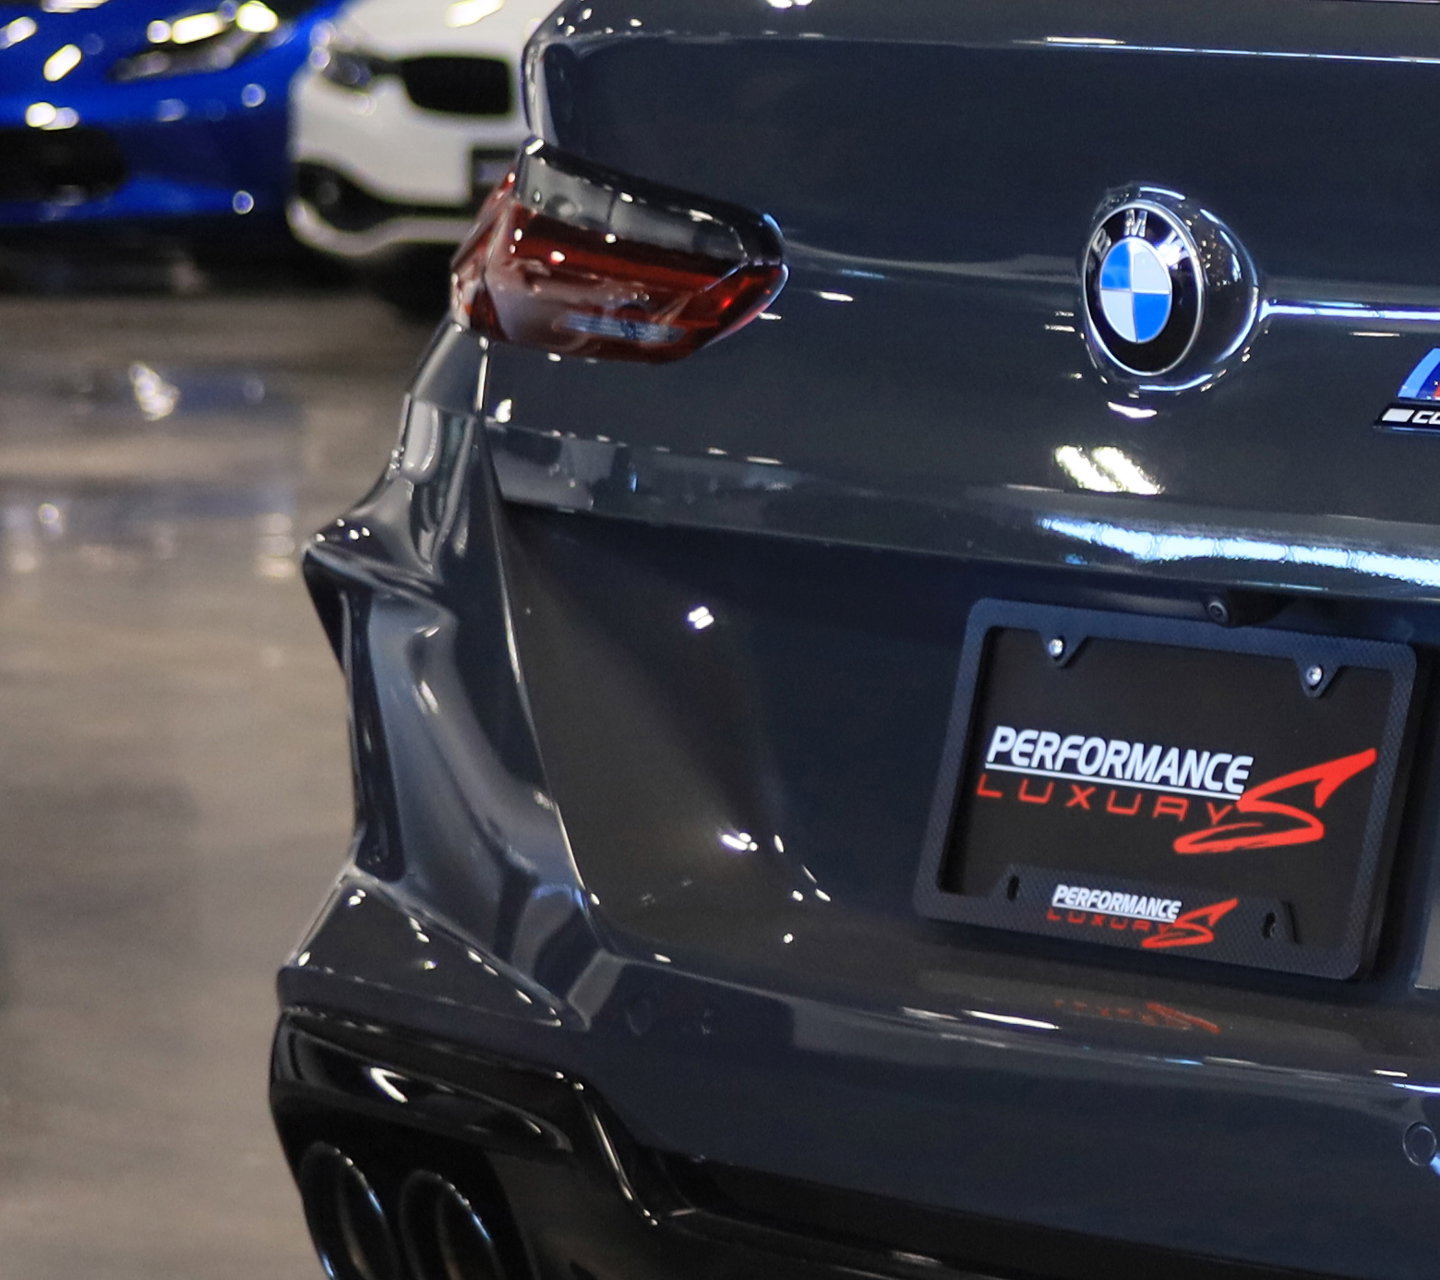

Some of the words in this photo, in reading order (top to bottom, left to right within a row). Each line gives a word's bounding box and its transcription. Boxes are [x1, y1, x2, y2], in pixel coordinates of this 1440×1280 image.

[1092, 209, 1190, 269] BMW
[987, 726, 1254, 794] PERFORMANCE
[976, 773, 1236, 825] LUXURY
[1045, 908, 1172, 935] LUXURY
[1052, 884, 1182, 920] PERFORMANCE
